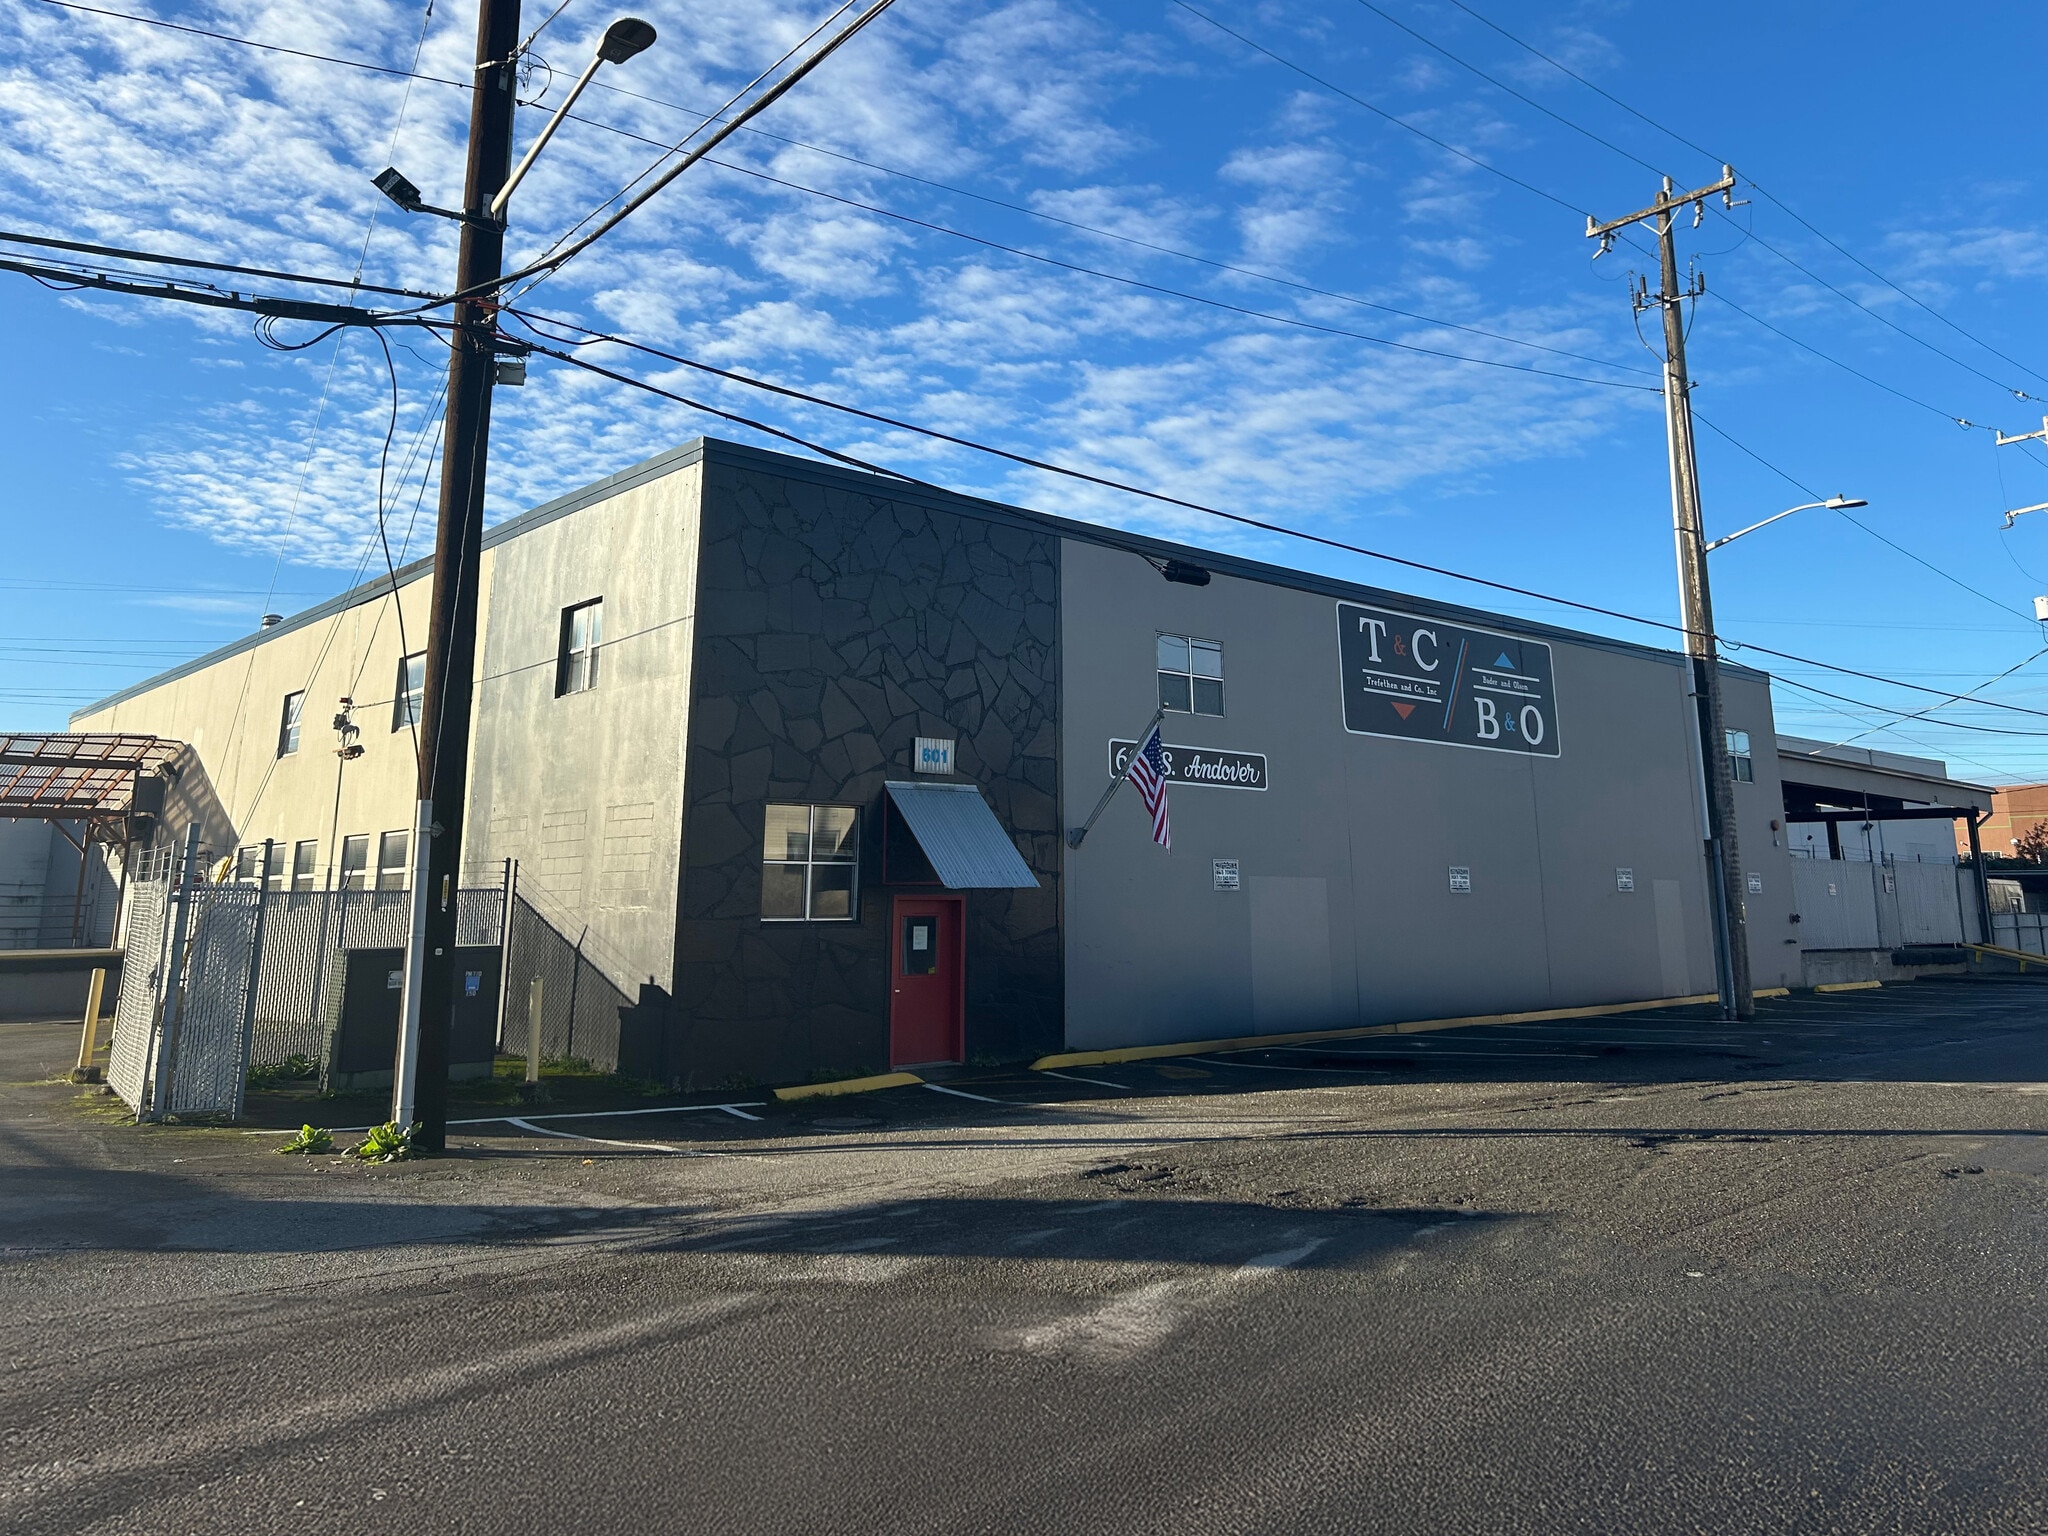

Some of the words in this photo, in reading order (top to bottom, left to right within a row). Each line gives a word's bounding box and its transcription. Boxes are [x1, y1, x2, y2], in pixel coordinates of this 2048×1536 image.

[1359, 616, 1387, 663] T
[1393, 634, 1407, 657] &
[1411, 629, 1439, 672] C
[1400, 683, 1412, 692] and
[1473, 697, 1500, 740] B
[1504, 711, 1516, 732] &
[1520, 704, 1544, 746] O
[1184, 754, 1260, 784] Andover
